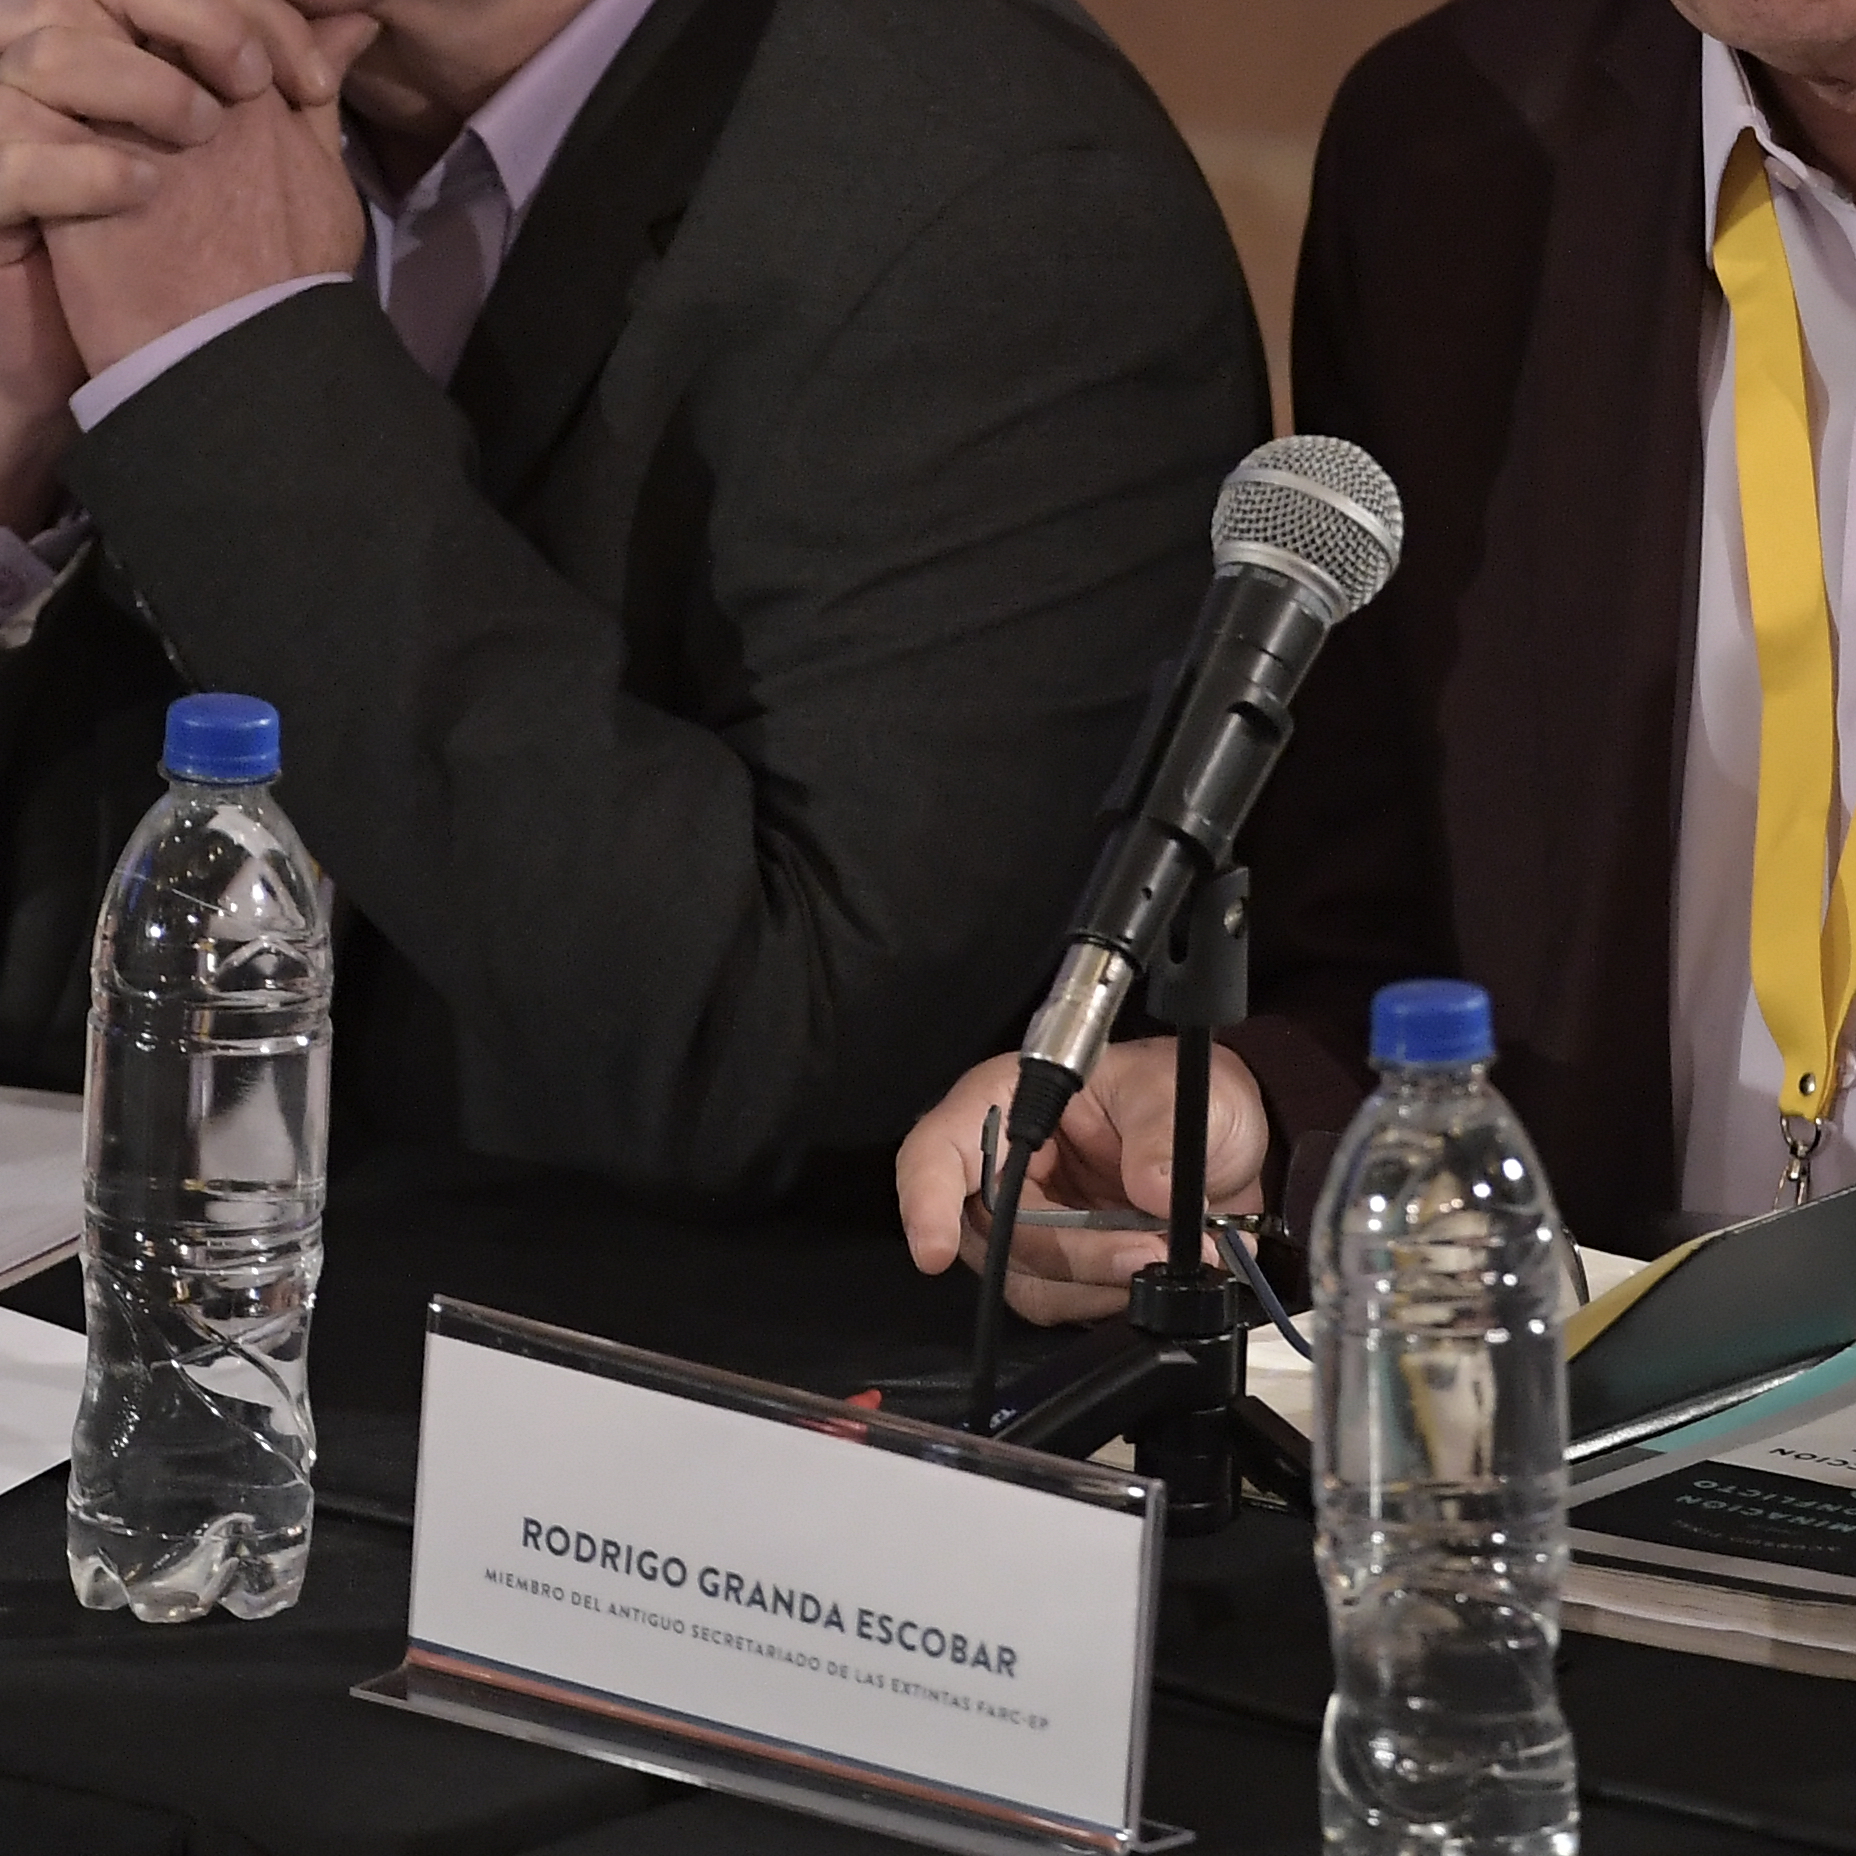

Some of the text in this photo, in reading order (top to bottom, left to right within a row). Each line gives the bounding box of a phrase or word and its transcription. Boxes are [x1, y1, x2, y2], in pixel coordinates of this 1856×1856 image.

[484, 1568, 565, 1602] MIEMBRO
[571, 1591, 601, 1613] DEL
[607, 1603, 685, 1635] ANTIGUO
[691, 1624, 821, 1671] SECRETARIADO
[826, 1661, 848, 1680] DE
[855, 1670, 885, 1689] LAS
[891, 1678, 970, 1711] EXTINTAS
[523, 1518, 1016, 1677] RODRIGO GRANDA ESCOBAR
